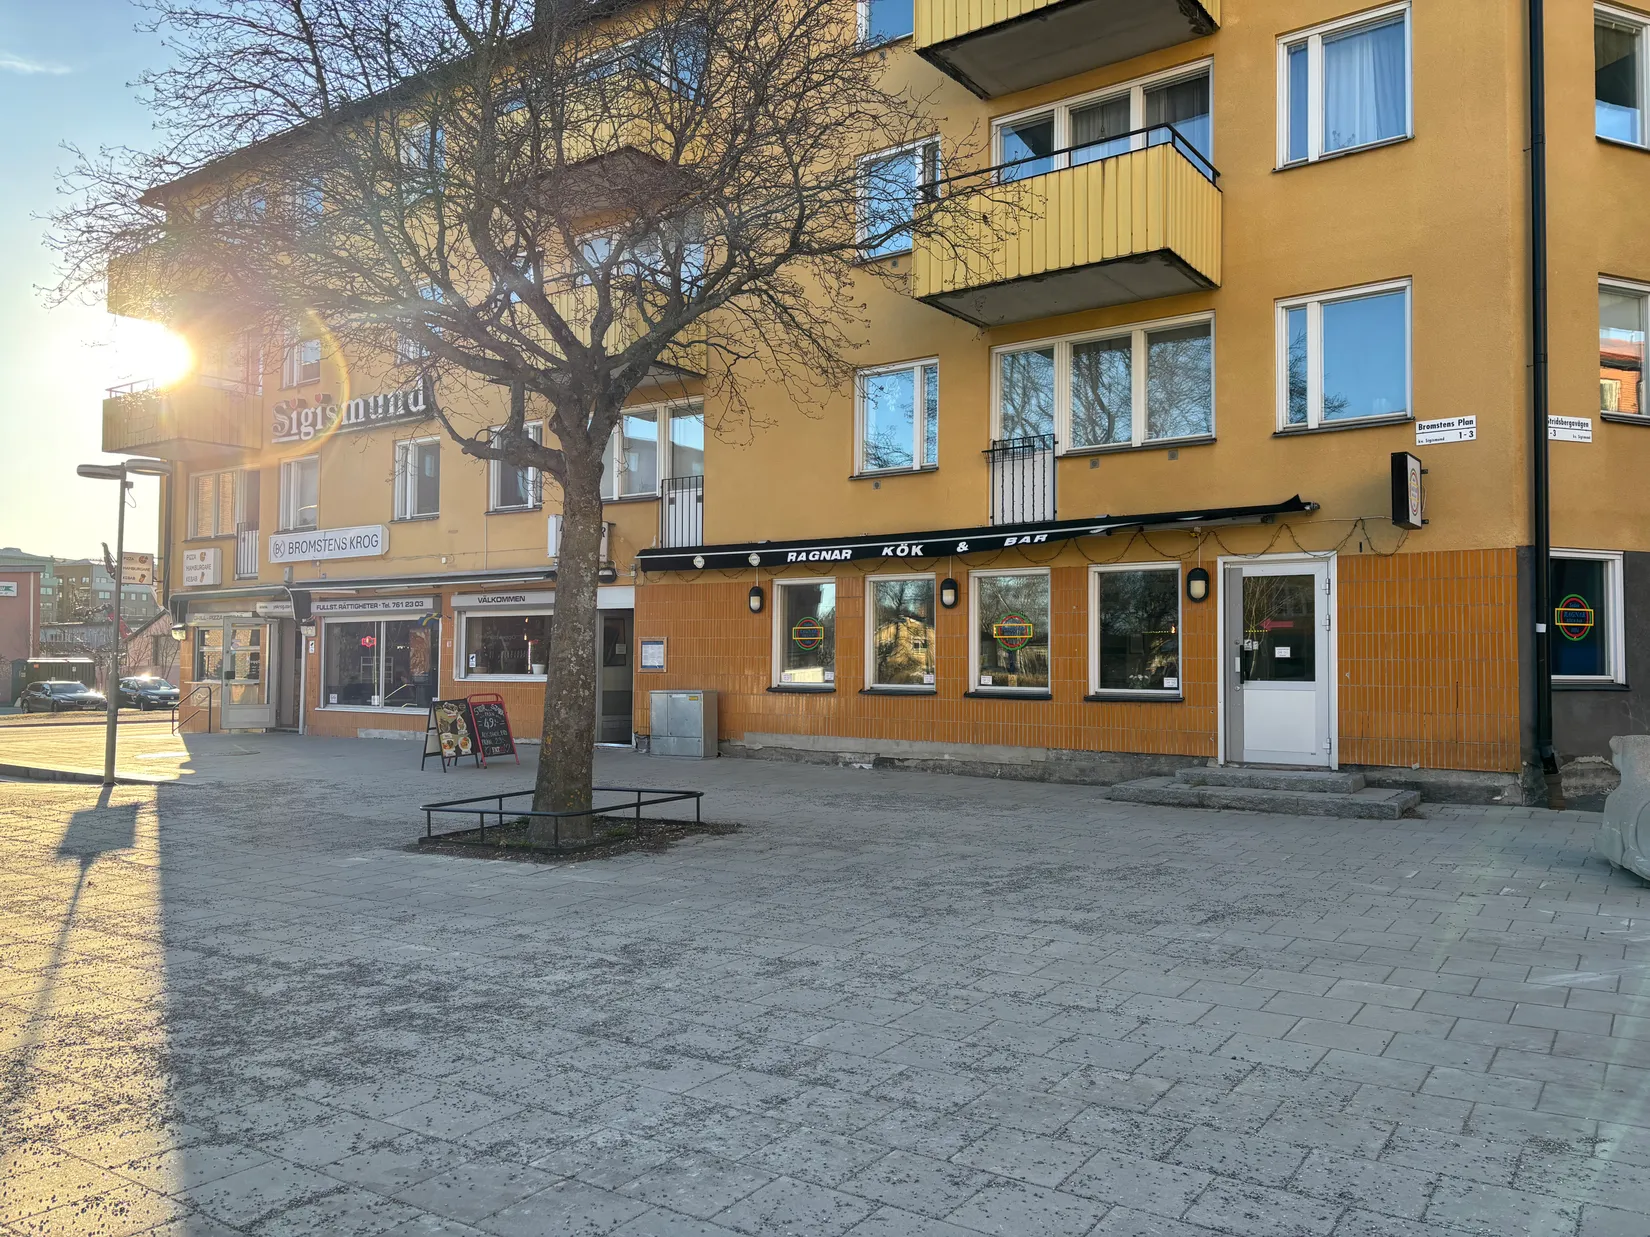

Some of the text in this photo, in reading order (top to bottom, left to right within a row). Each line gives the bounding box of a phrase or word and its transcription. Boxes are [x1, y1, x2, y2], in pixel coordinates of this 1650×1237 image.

[272, 373, 427, 440] Sigismund
[1418, 417, 1474, 431] Bromstens Plan
[288, 537, 348, 555] BROMSTENS
[349, 534, 379, 550] KROG
[787, 534, 1049, 562] RAGNAR KÖK & BAR
[338, 602, 379, 610] RÄTTIGHETER
[477, 595, 526, 604] VÄLKOMMEN
